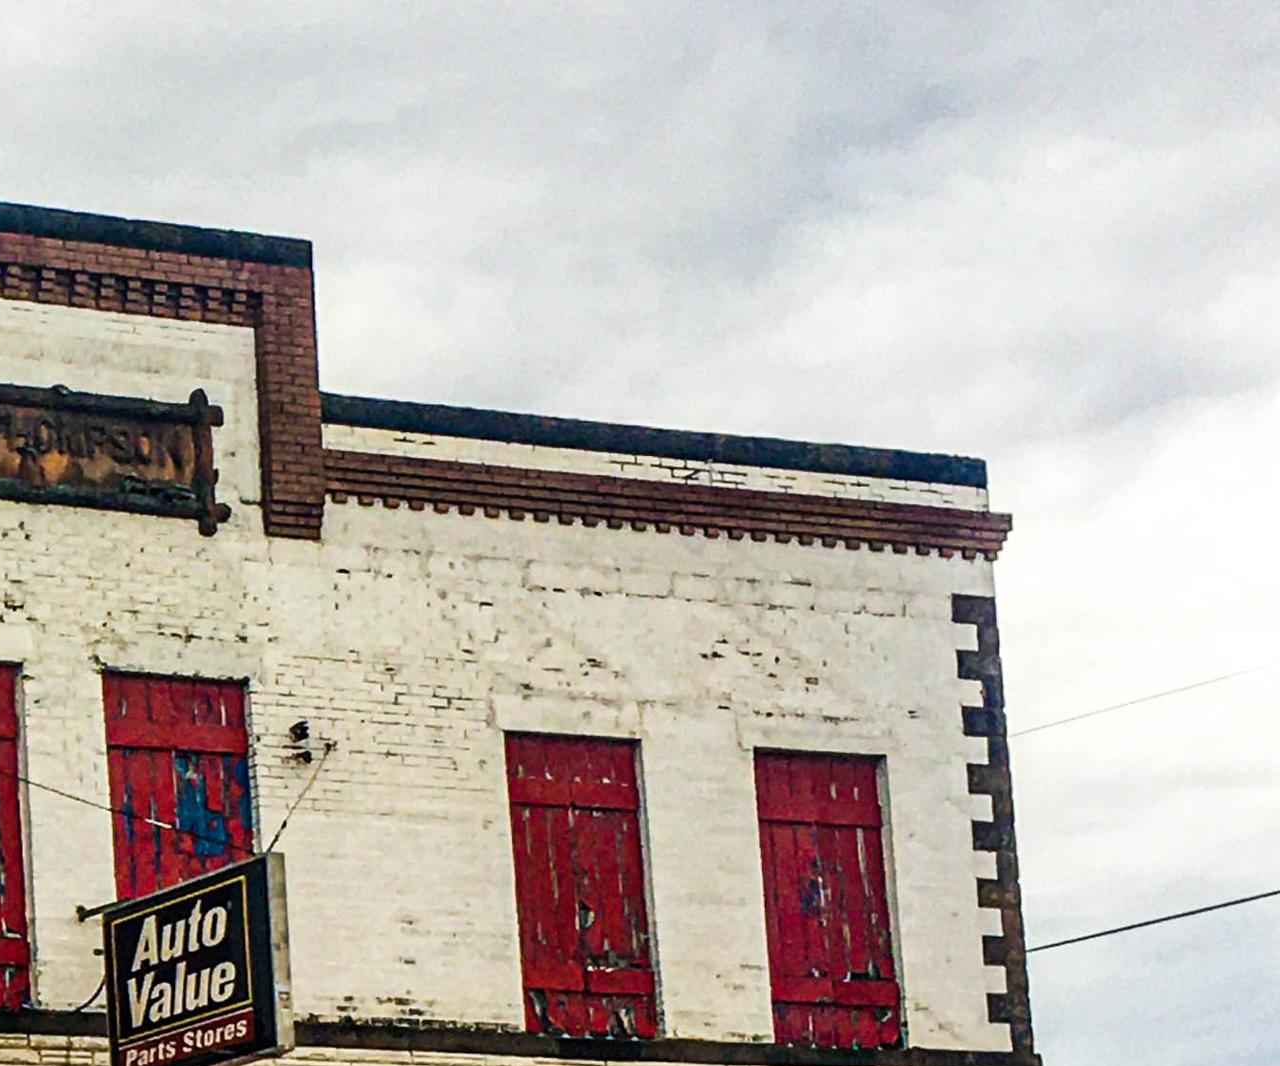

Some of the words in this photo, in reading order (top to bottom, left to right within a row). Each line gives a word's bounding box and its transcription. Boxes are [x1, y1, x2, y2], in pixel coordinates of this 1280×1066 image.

[131, 899, 228, 972] Auto
[126, 961, 236, 1028] Value
[182, 1018, 248, 1053] Stores
